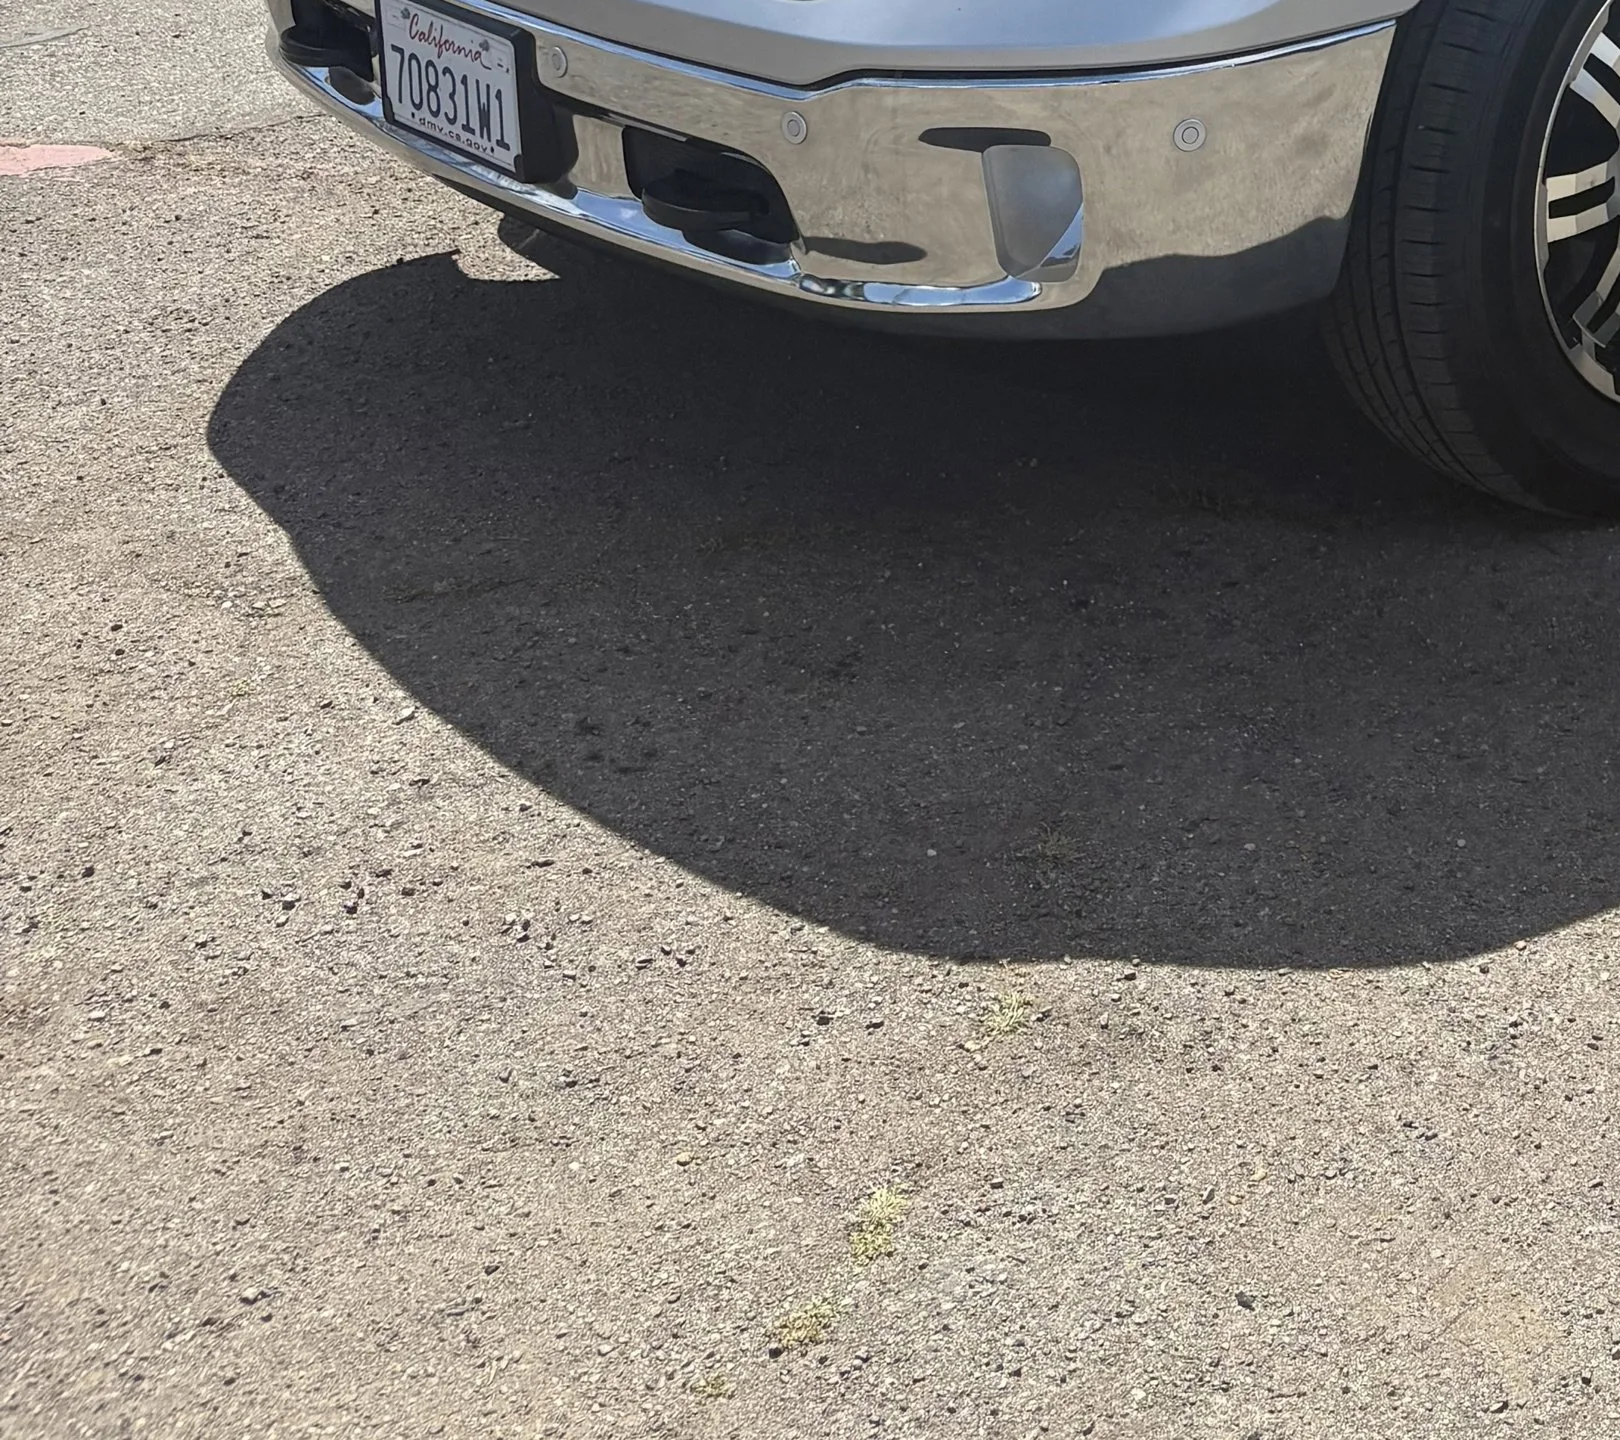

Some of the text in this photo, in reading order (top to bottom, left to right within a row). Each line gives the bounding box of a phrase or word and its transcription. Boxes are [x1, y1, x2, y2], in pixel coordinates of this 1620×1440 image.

[409, 13, 492, 70] California
[390, 44, 511, 152] 70831W1
[419, 116, 488, 154] dmv.ca.gov
